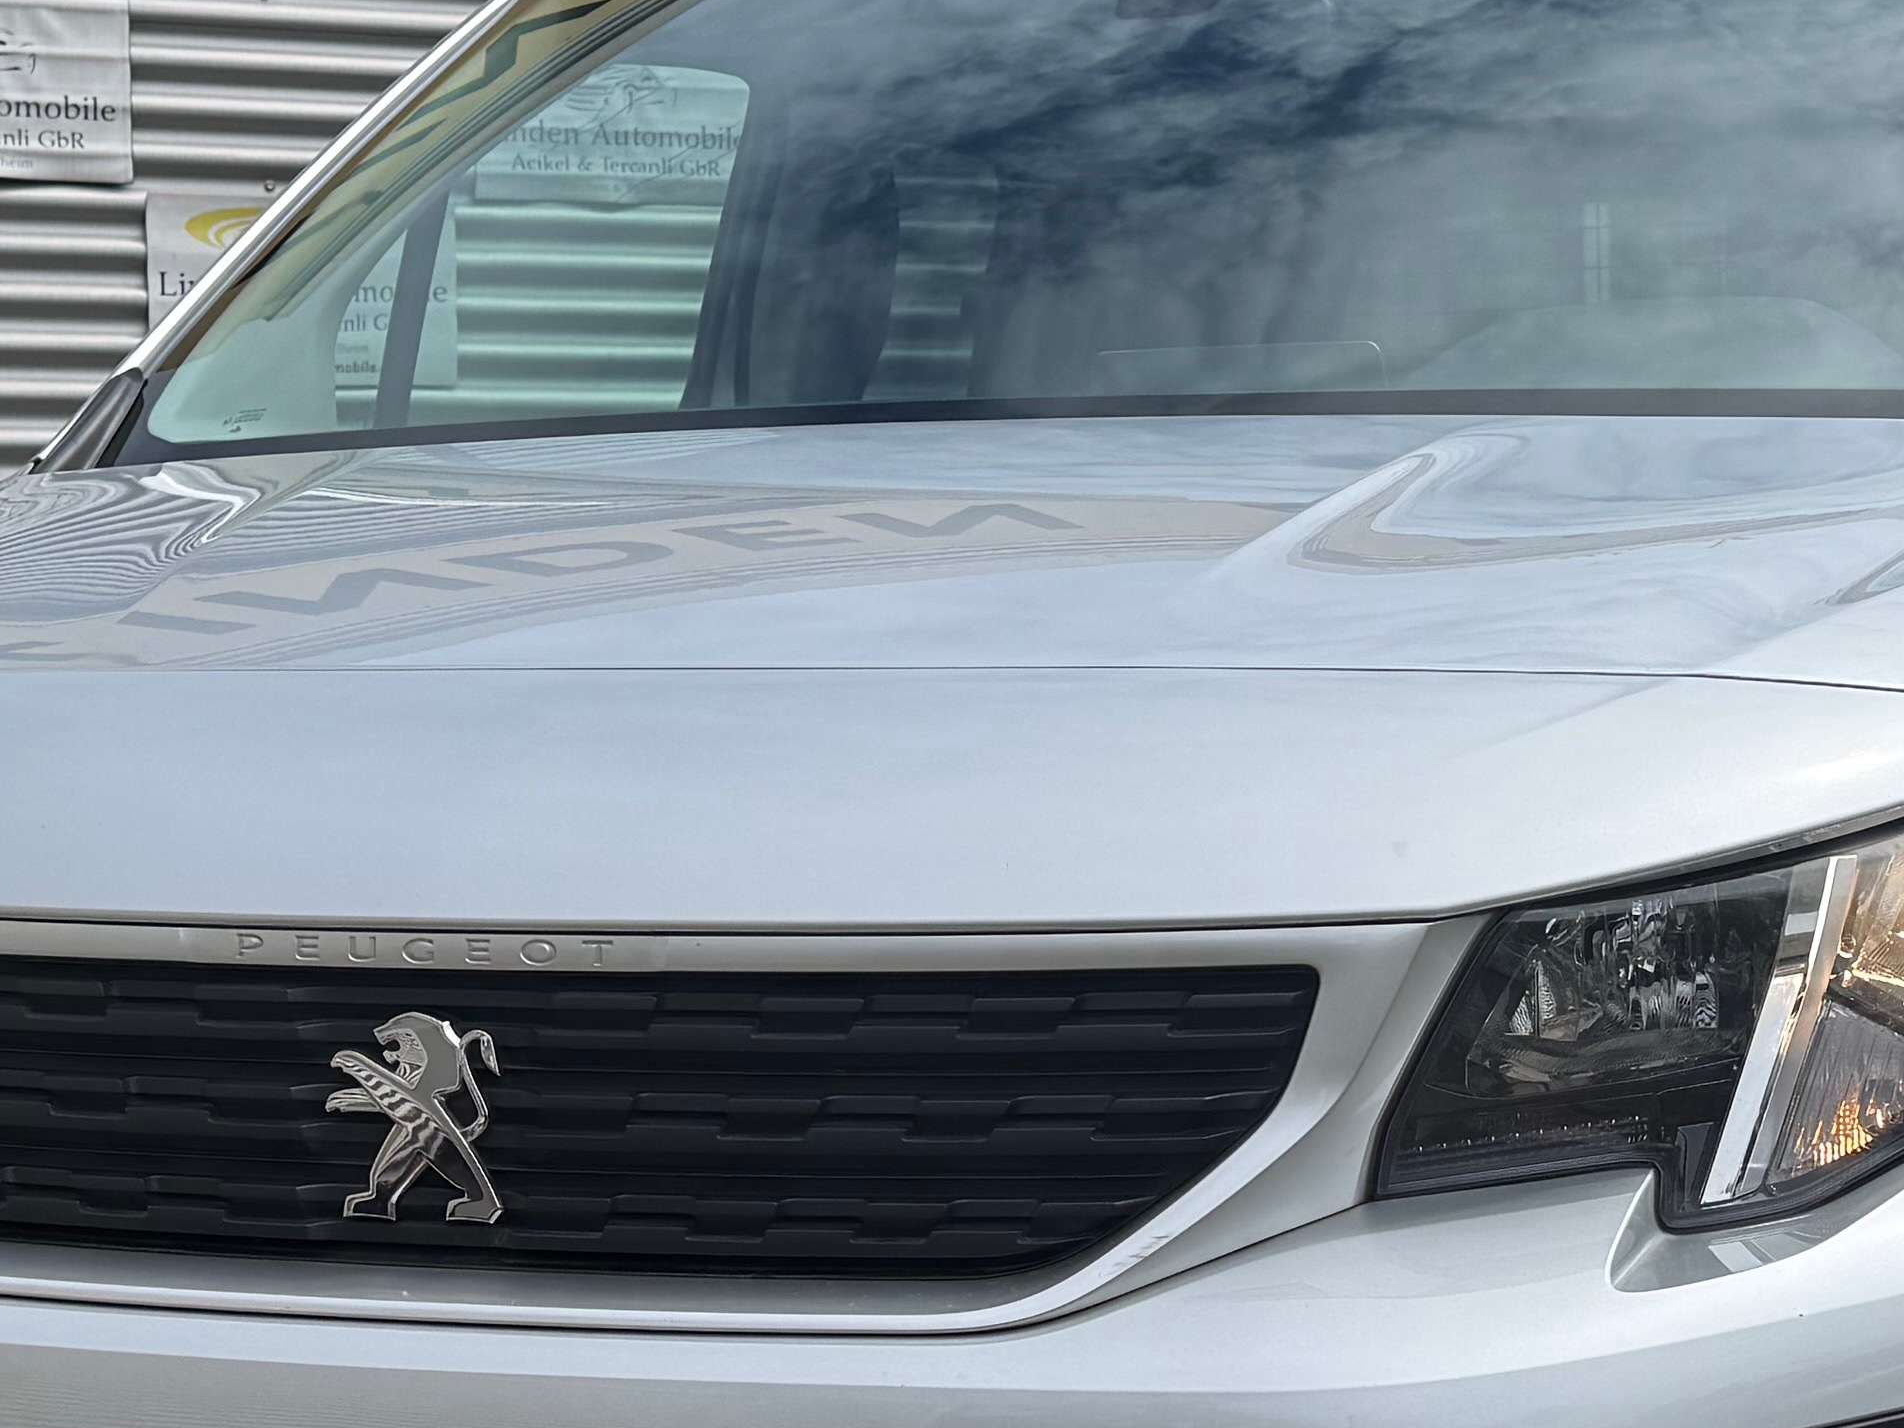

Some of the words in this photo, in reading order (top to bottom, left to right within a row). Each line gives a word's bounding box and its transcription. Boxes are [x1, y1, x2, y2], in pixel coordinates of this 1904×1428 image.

[38, 129, 85, 149] GbR
[508, 119, 579, 146] nden
[235, 932, 615, 967] PEUGEOT
